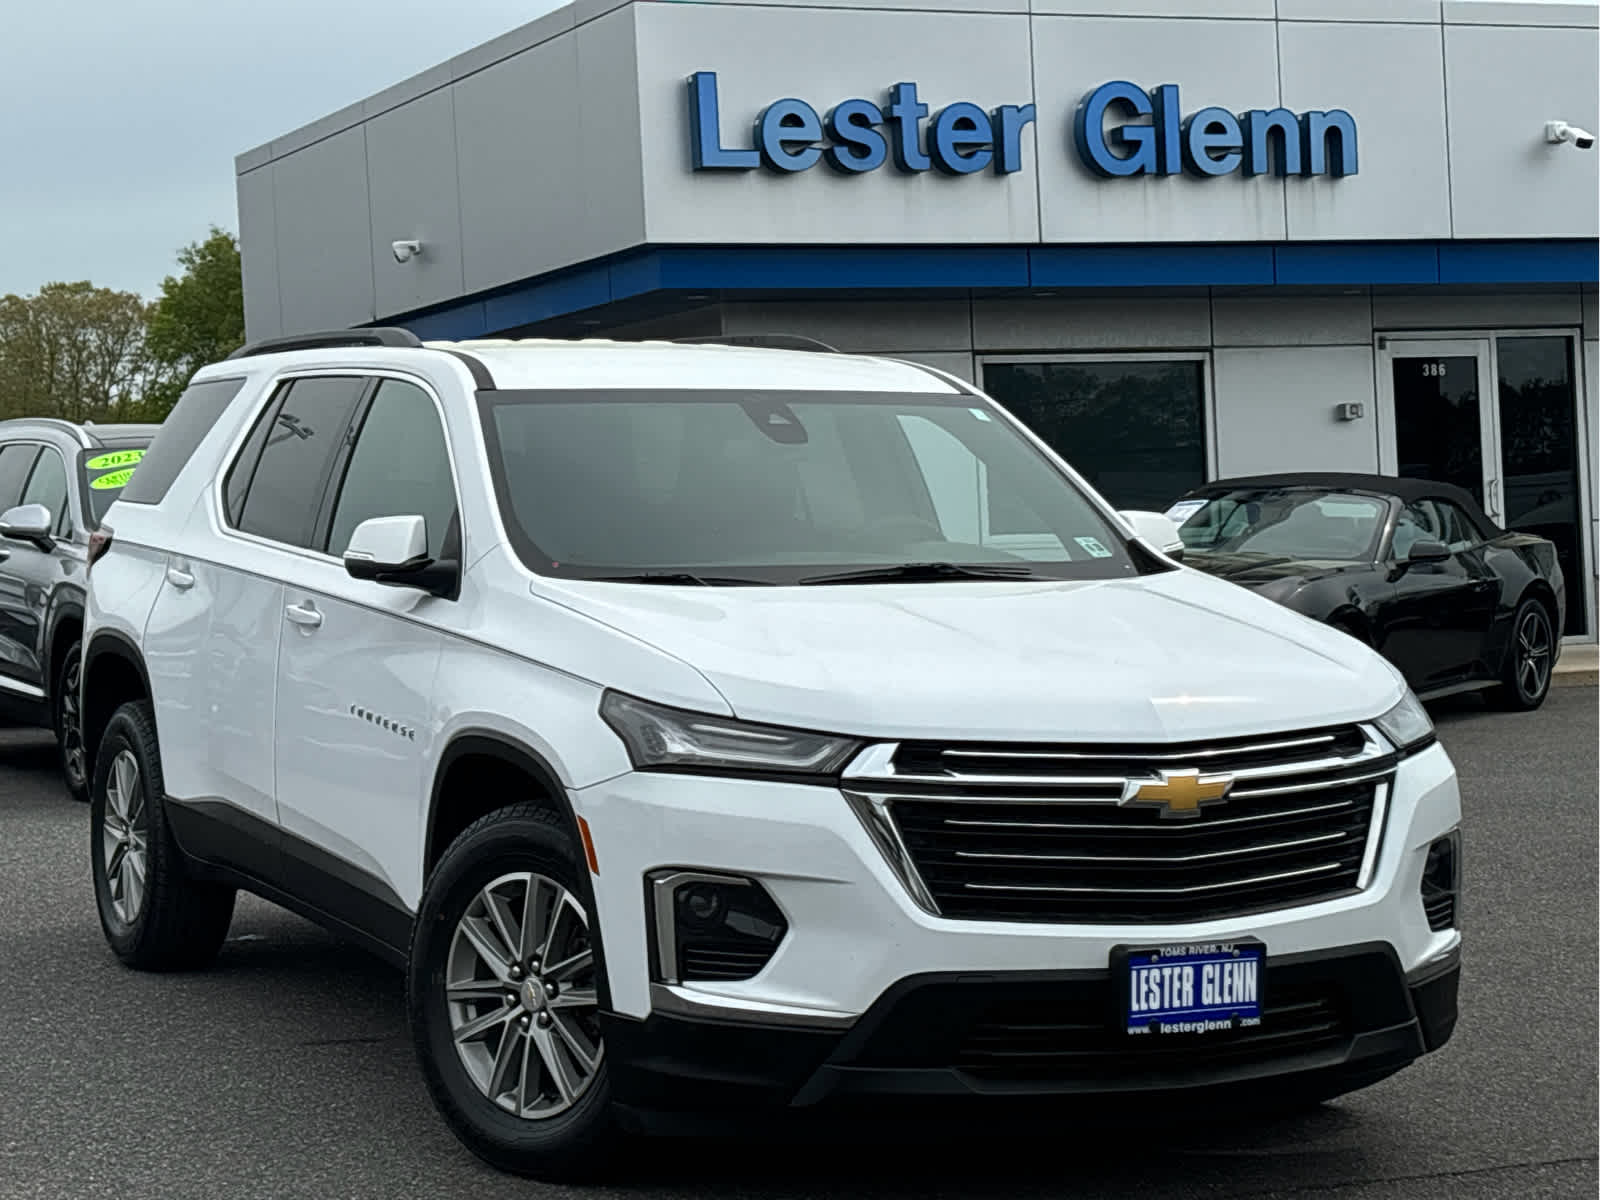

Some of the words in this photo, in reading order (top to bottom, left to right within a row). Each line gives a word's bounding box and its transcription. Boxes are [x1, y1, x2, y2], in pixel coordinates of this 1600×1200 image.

[687, 71, 1036, 175] Lester
[1075, 80, 1359, 179] Glenn
[1422, 363, 1446, 377] 386
[1160, 945, 1187, 957] TOMS
[1131, 965, 1194, 1012] LESTER
[1201, 961, 1257, 1006] GLENN
[1160, 1019, 1232, 1034] lesterglenn
